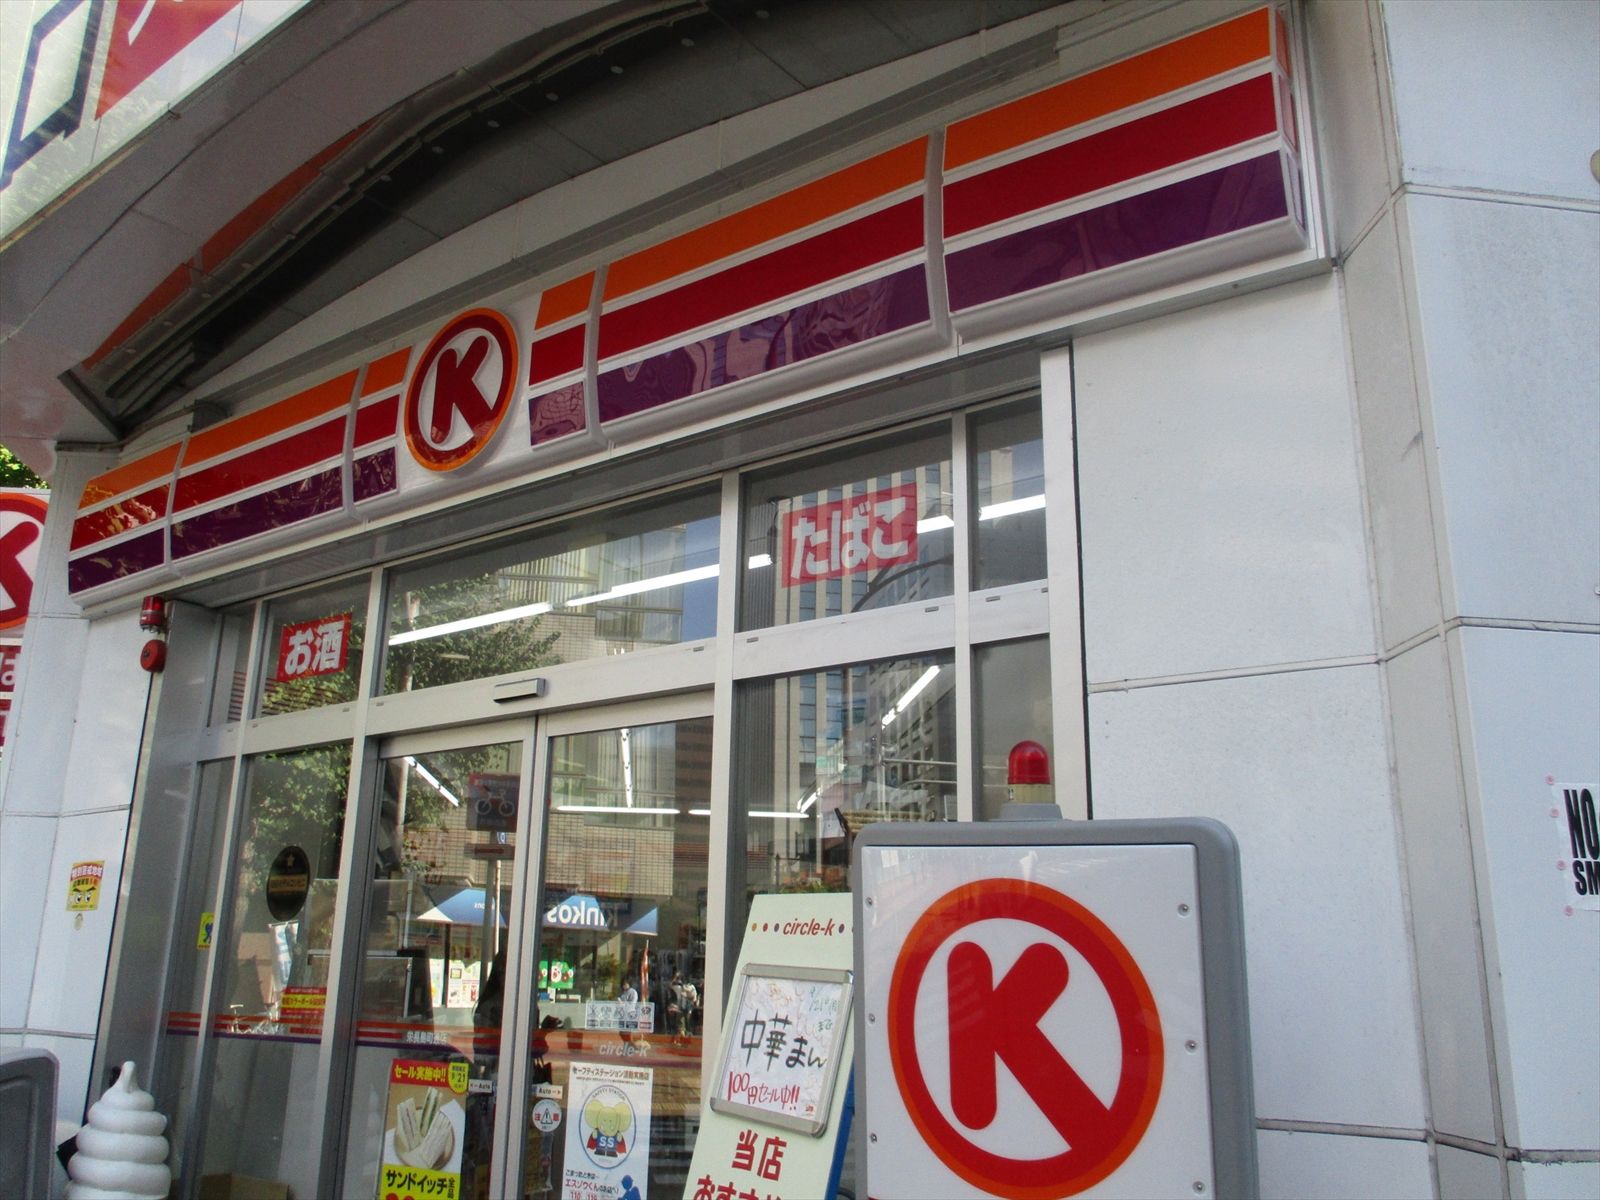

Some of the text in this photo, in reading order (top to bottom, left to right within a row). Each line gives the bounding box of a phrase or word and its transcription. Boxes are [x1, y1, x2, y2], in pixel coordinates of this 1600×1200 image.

[791, 496, 909, 577] たばこ
[284, 622, 344, 676] お酒
[1563, 788, 1600, 860] NO
[783, 917, 837, 937] circle-k
[741, 1008, 828, 1072] 中華まん
[599, 1136, 615, 1148] SS
[732, 1129, 787, 1181] 当店
[386, 1169, 448, 1195] サンドイッチ
